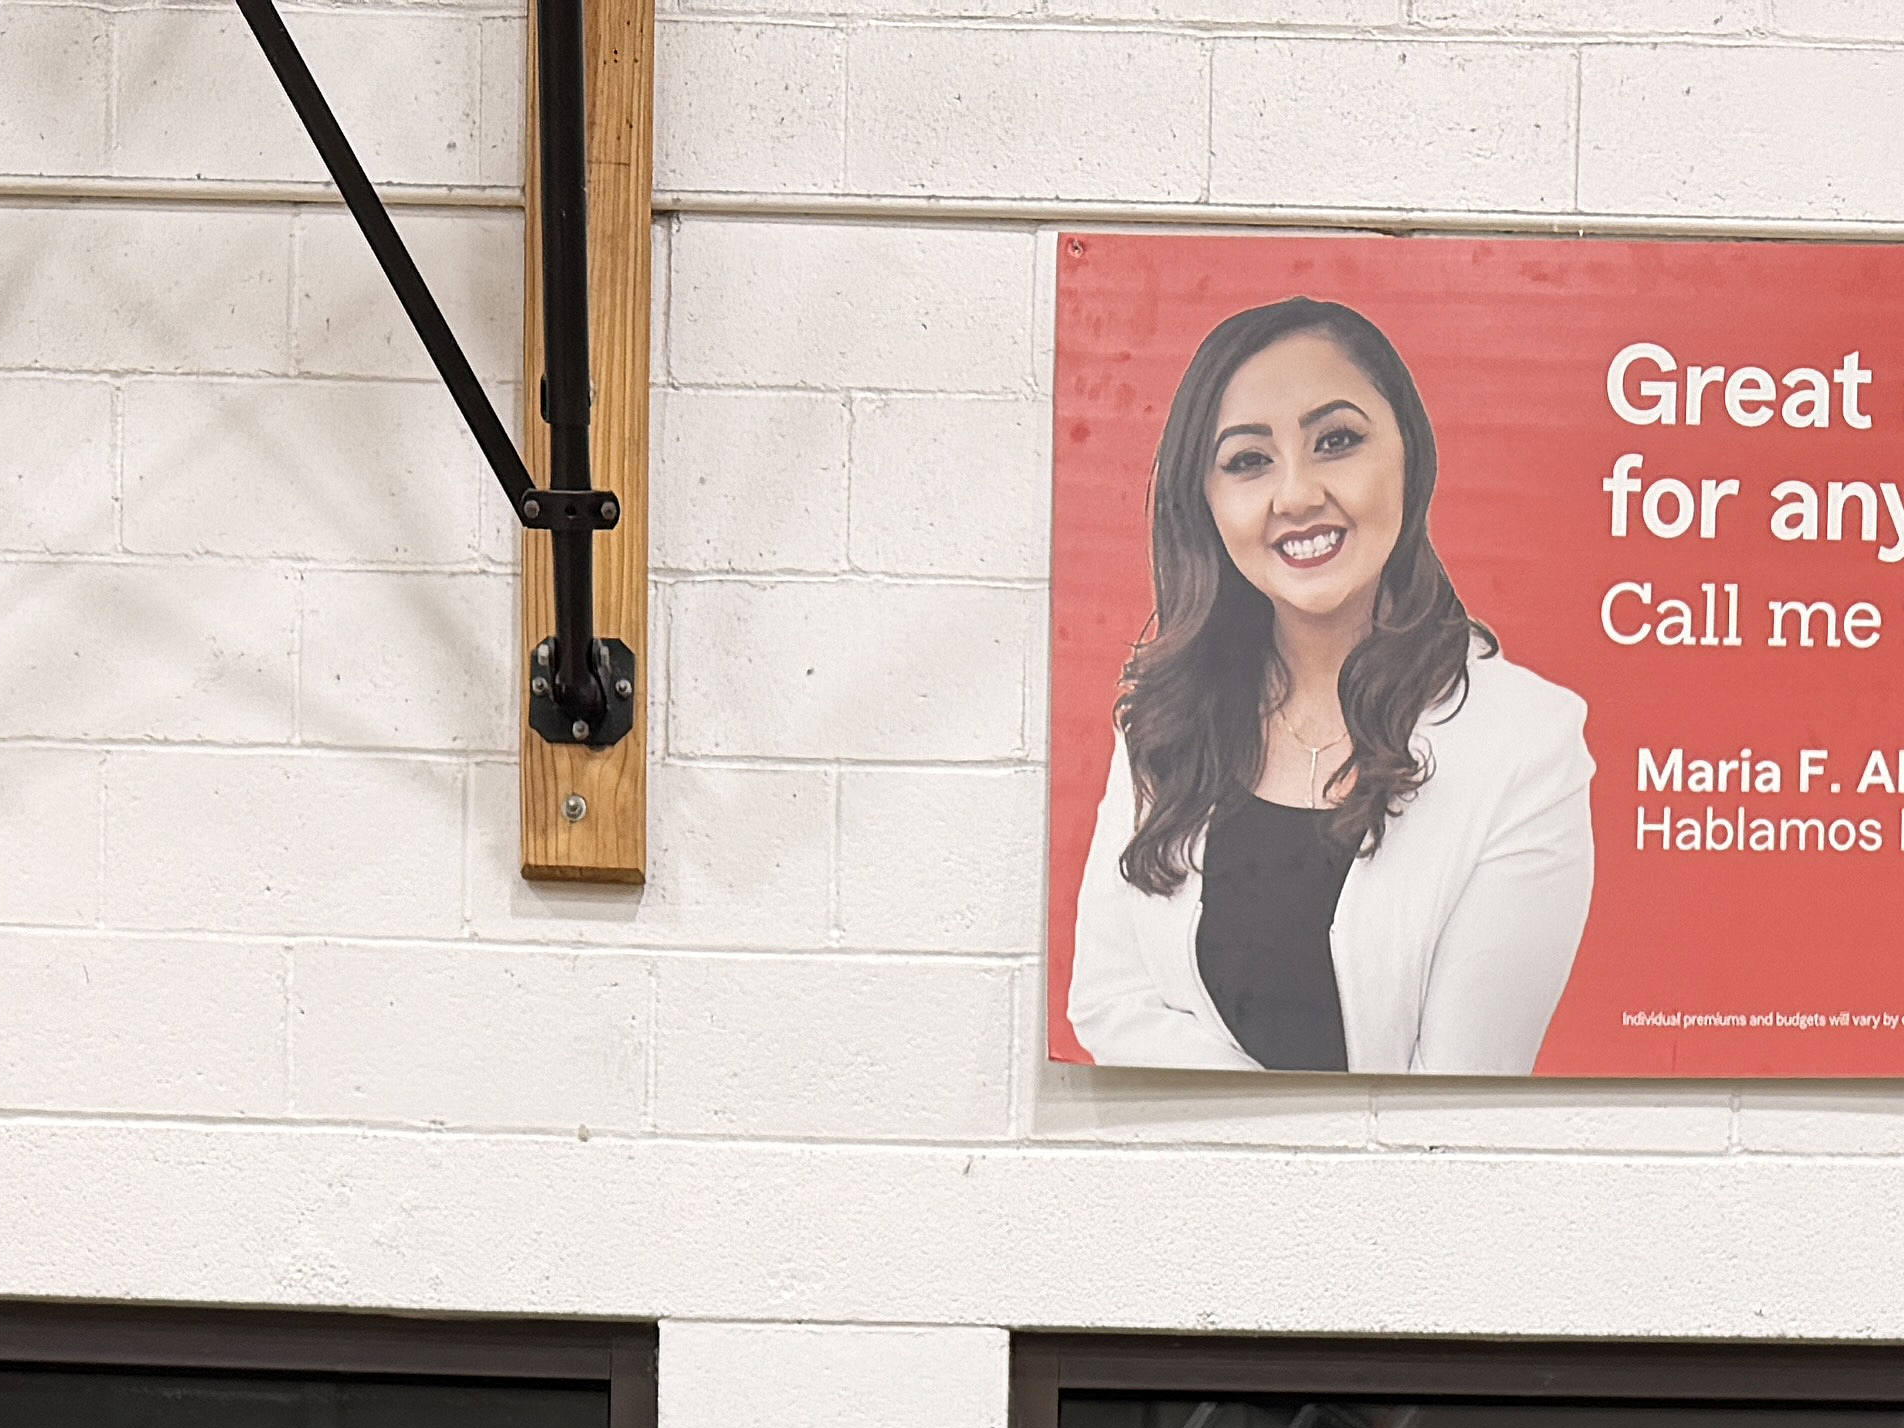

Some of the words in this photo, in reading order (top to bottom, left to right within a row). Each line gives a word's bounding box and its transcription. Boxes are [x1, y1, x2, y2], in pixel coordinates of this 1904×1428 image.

[1607, 343, 1871, 429] Great
[1603, 454, 1739, 538] for
[1601, 582, 1741, 648] Call
[1768, 602, 1881, 648] me
[1638, 748, 1780, 793] Maria
[1800, 750, 1842, 793] F.
[1637, 807, 1882, 853] Hablamos
[1623, 1011, 1681, 1027] Individual
[1683, 1012, 1747, 1029] premiums
[1749, 1011, 1773, 1026] and
[1776, 1011, 1826, 1030] budgets
[1829, 1012, 1849, 1026] will
[1852, 1014, 1880, 1029] vary
[1883, 1012, 1898, 1030] by
